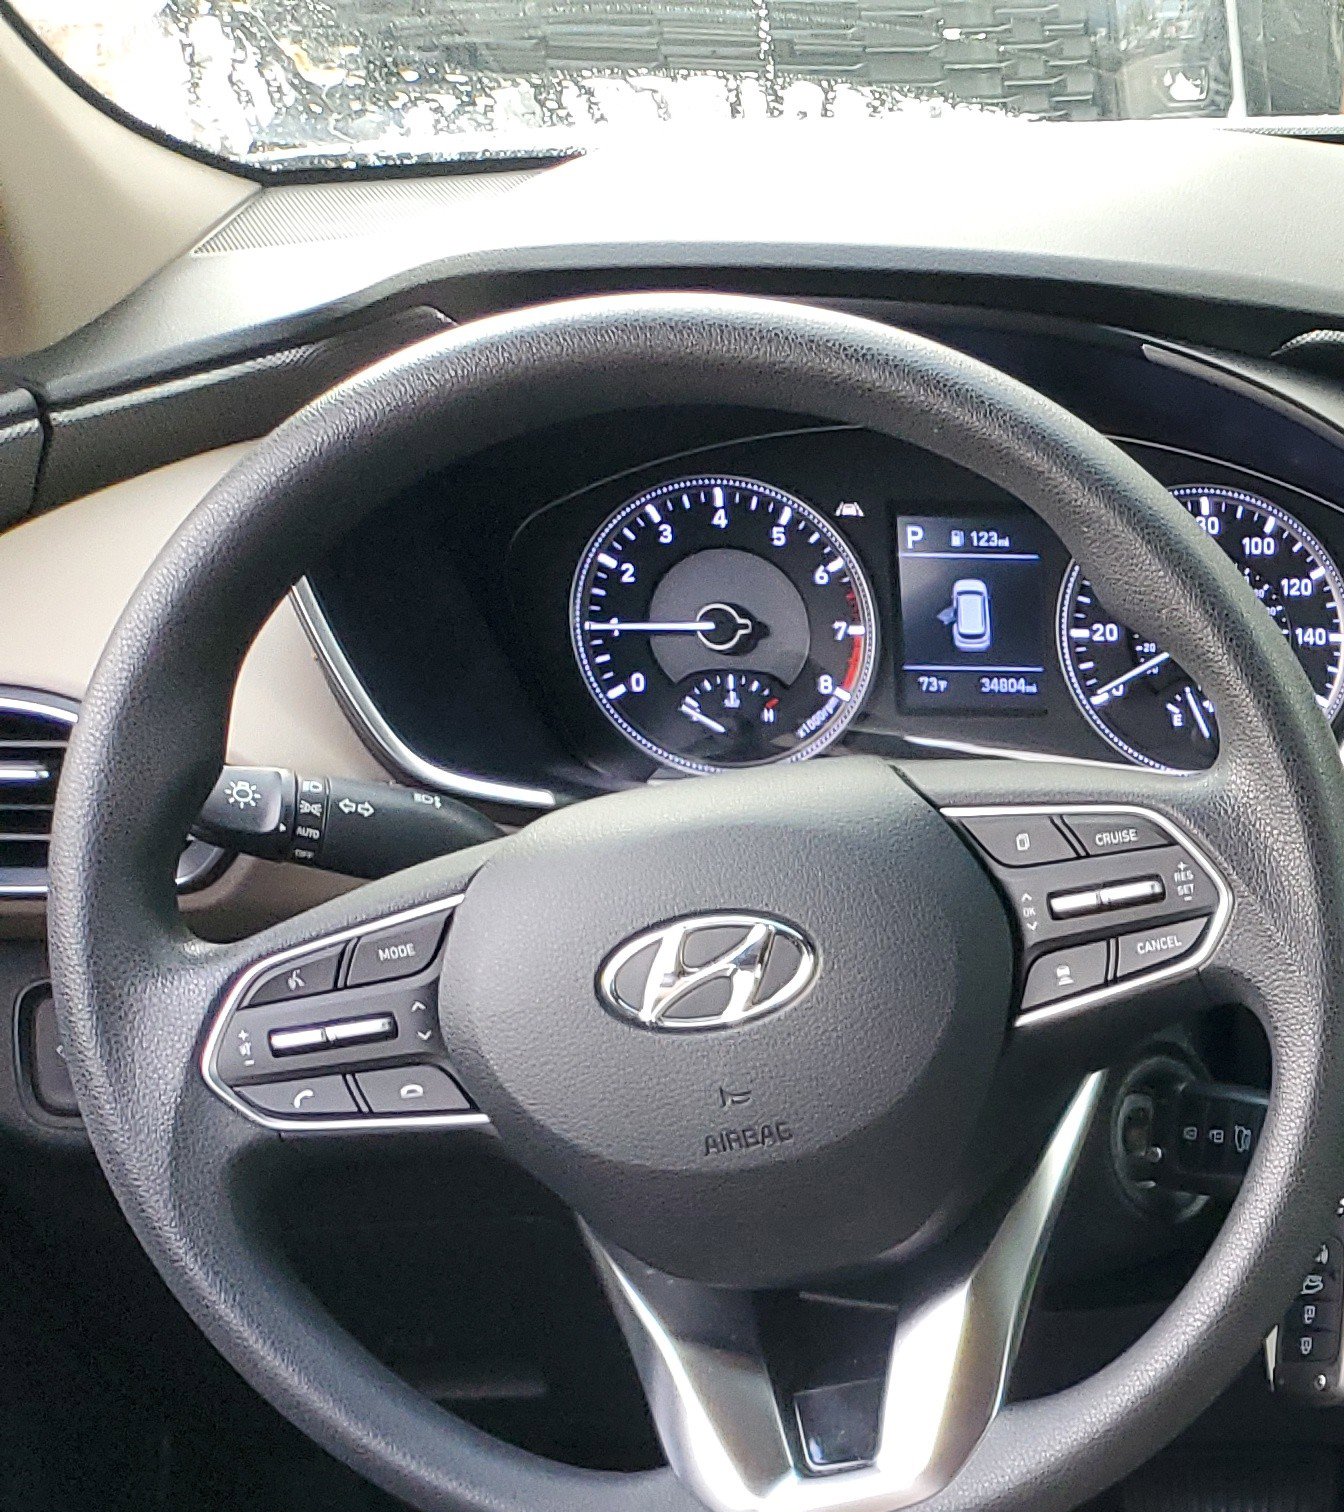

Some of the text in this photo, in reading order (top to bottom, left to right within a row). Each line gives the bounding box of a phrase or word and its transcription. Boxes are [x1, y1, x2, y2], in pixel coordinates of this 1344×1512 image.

[712, 507, 728, 528] 4
[658, 523, 673, 544] 3
[771, 526, 786, 546] 5
[906, 525, 924, 549] P
[1241, 536, 1276, 556] 100
[620, 562, 636, 583] 2
[814, 566, 829, 585] 6
[1280, 577, 1313, 597] 120
[832, 620, 847, 641] 7
[1091, 622, 1119, 642] 20
[1294, 626, 1327, 646] 140
[630, 672, 646, 693] 0
[817, 674, 834, 695] 8
[1172, 713, 1183, 727] E
[296, 825, 320, 840] AUTO
[1095, 828, 1139, 847] CRUISE
[1177, 883, 1195, 897] SET
[1022, 906, 1036, 917] OK
[378, 942, 416, 962] MODE
[1136, 934, 1183, 955] CANCEL
[703, 1121, 795, 1157] AIRBAG
